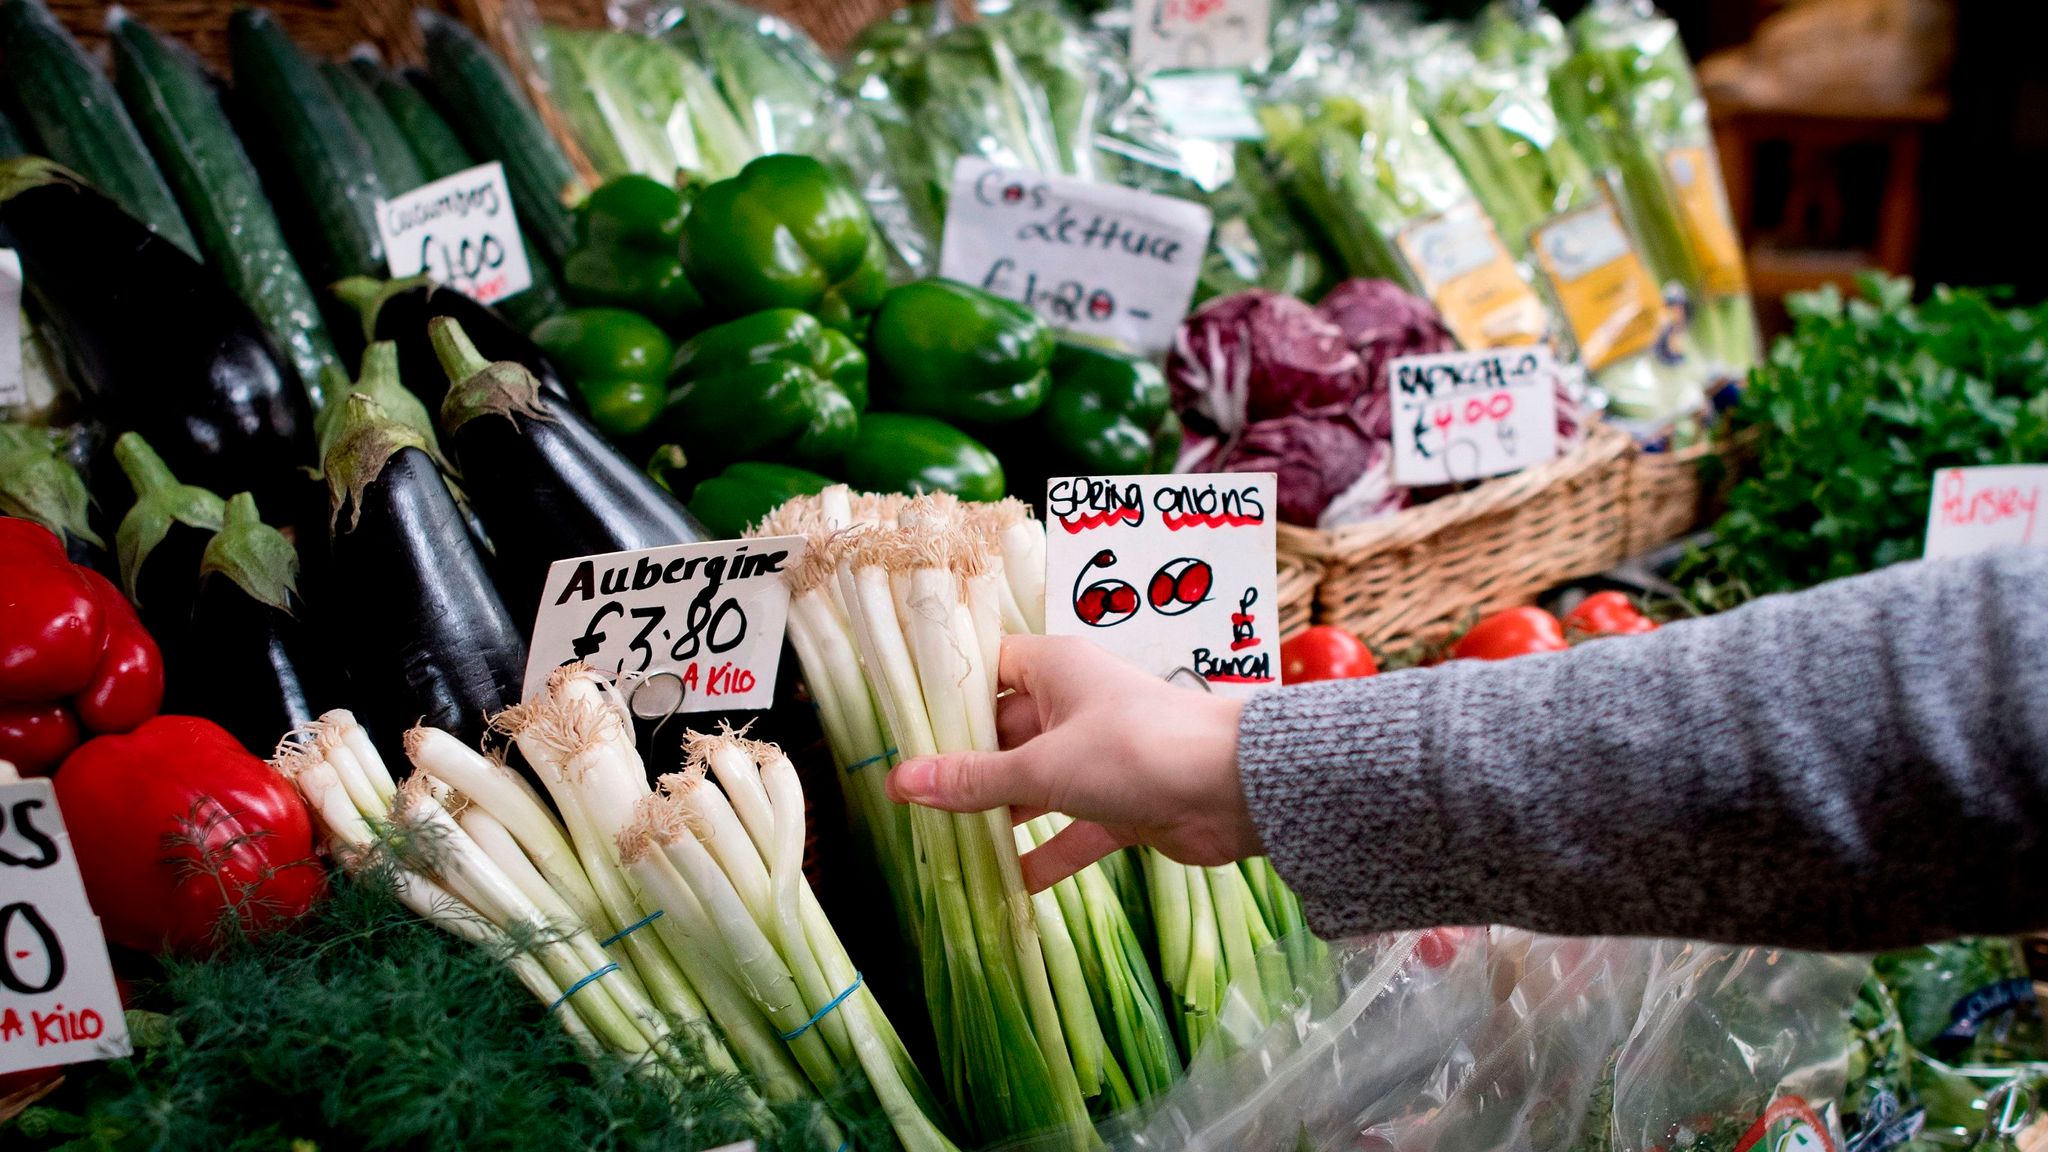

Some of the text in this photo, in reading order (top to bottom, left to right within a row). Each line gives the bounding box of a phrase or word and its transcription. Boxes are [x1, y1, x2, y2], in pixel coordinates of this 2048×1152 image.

[974, 169, 1047, 208] Cos
[555, 546, 788, 606] Aubergine
[1073, 549, 1215, 627] 60
[683, 662, 699, 691] A
